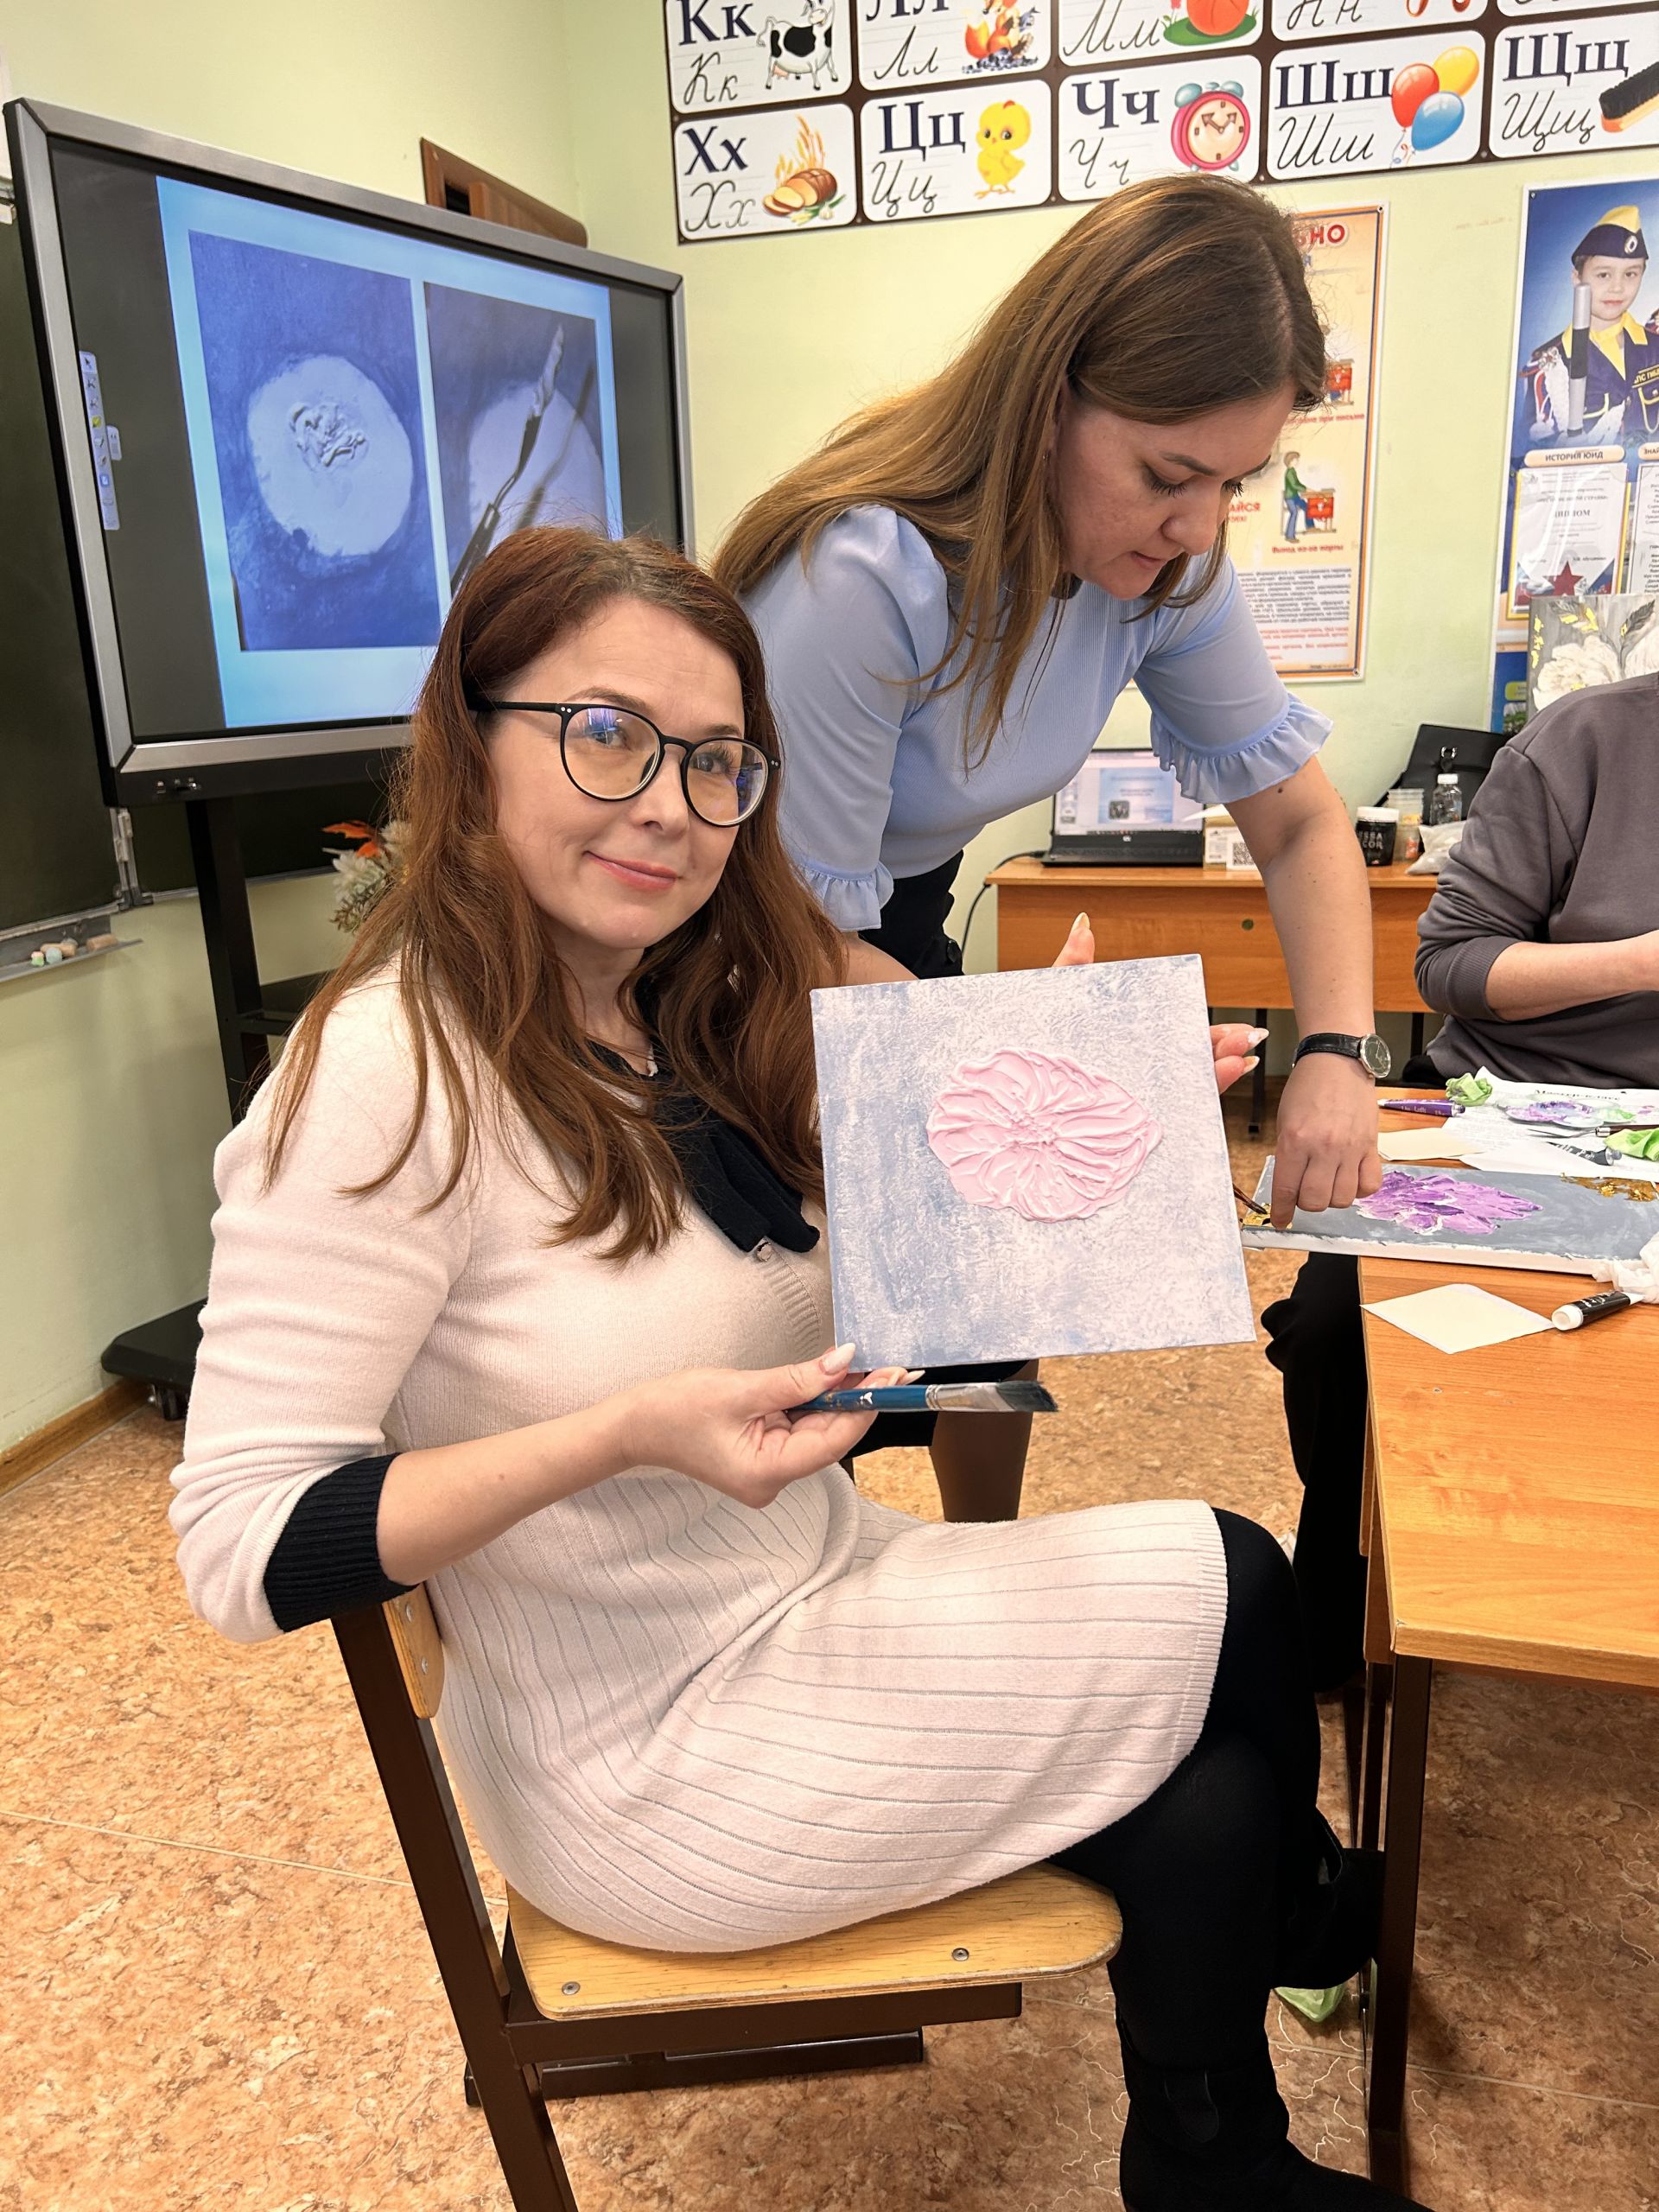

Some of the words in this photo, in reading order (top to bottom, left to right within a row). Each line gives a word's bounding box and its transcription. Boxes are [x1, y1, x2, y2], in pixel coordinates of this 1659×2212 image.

[678, 0, 757, 45] Кк
[874, 25, 939, 79] Лл
[1503, 31, 1630, 86] Щщ
[683, 53, 739, 105] Кк
[1071, 78, 1160, 130] Чч
[1274, 60, 1394, 110] Шш
[878, 101, 966, 162] Цц
[1277, 113, 1375, 170] Шш
[1501, 90, 1597, 151] Щщ
[682, 125, 749, 175] Хх
[1069, 137, 1130, 189] Чч
[684, 180, 756, 232] Хх
[871, 160, 938, 217] Цц
[1545, 452, 1581, 461] ИСТОРИЯ
